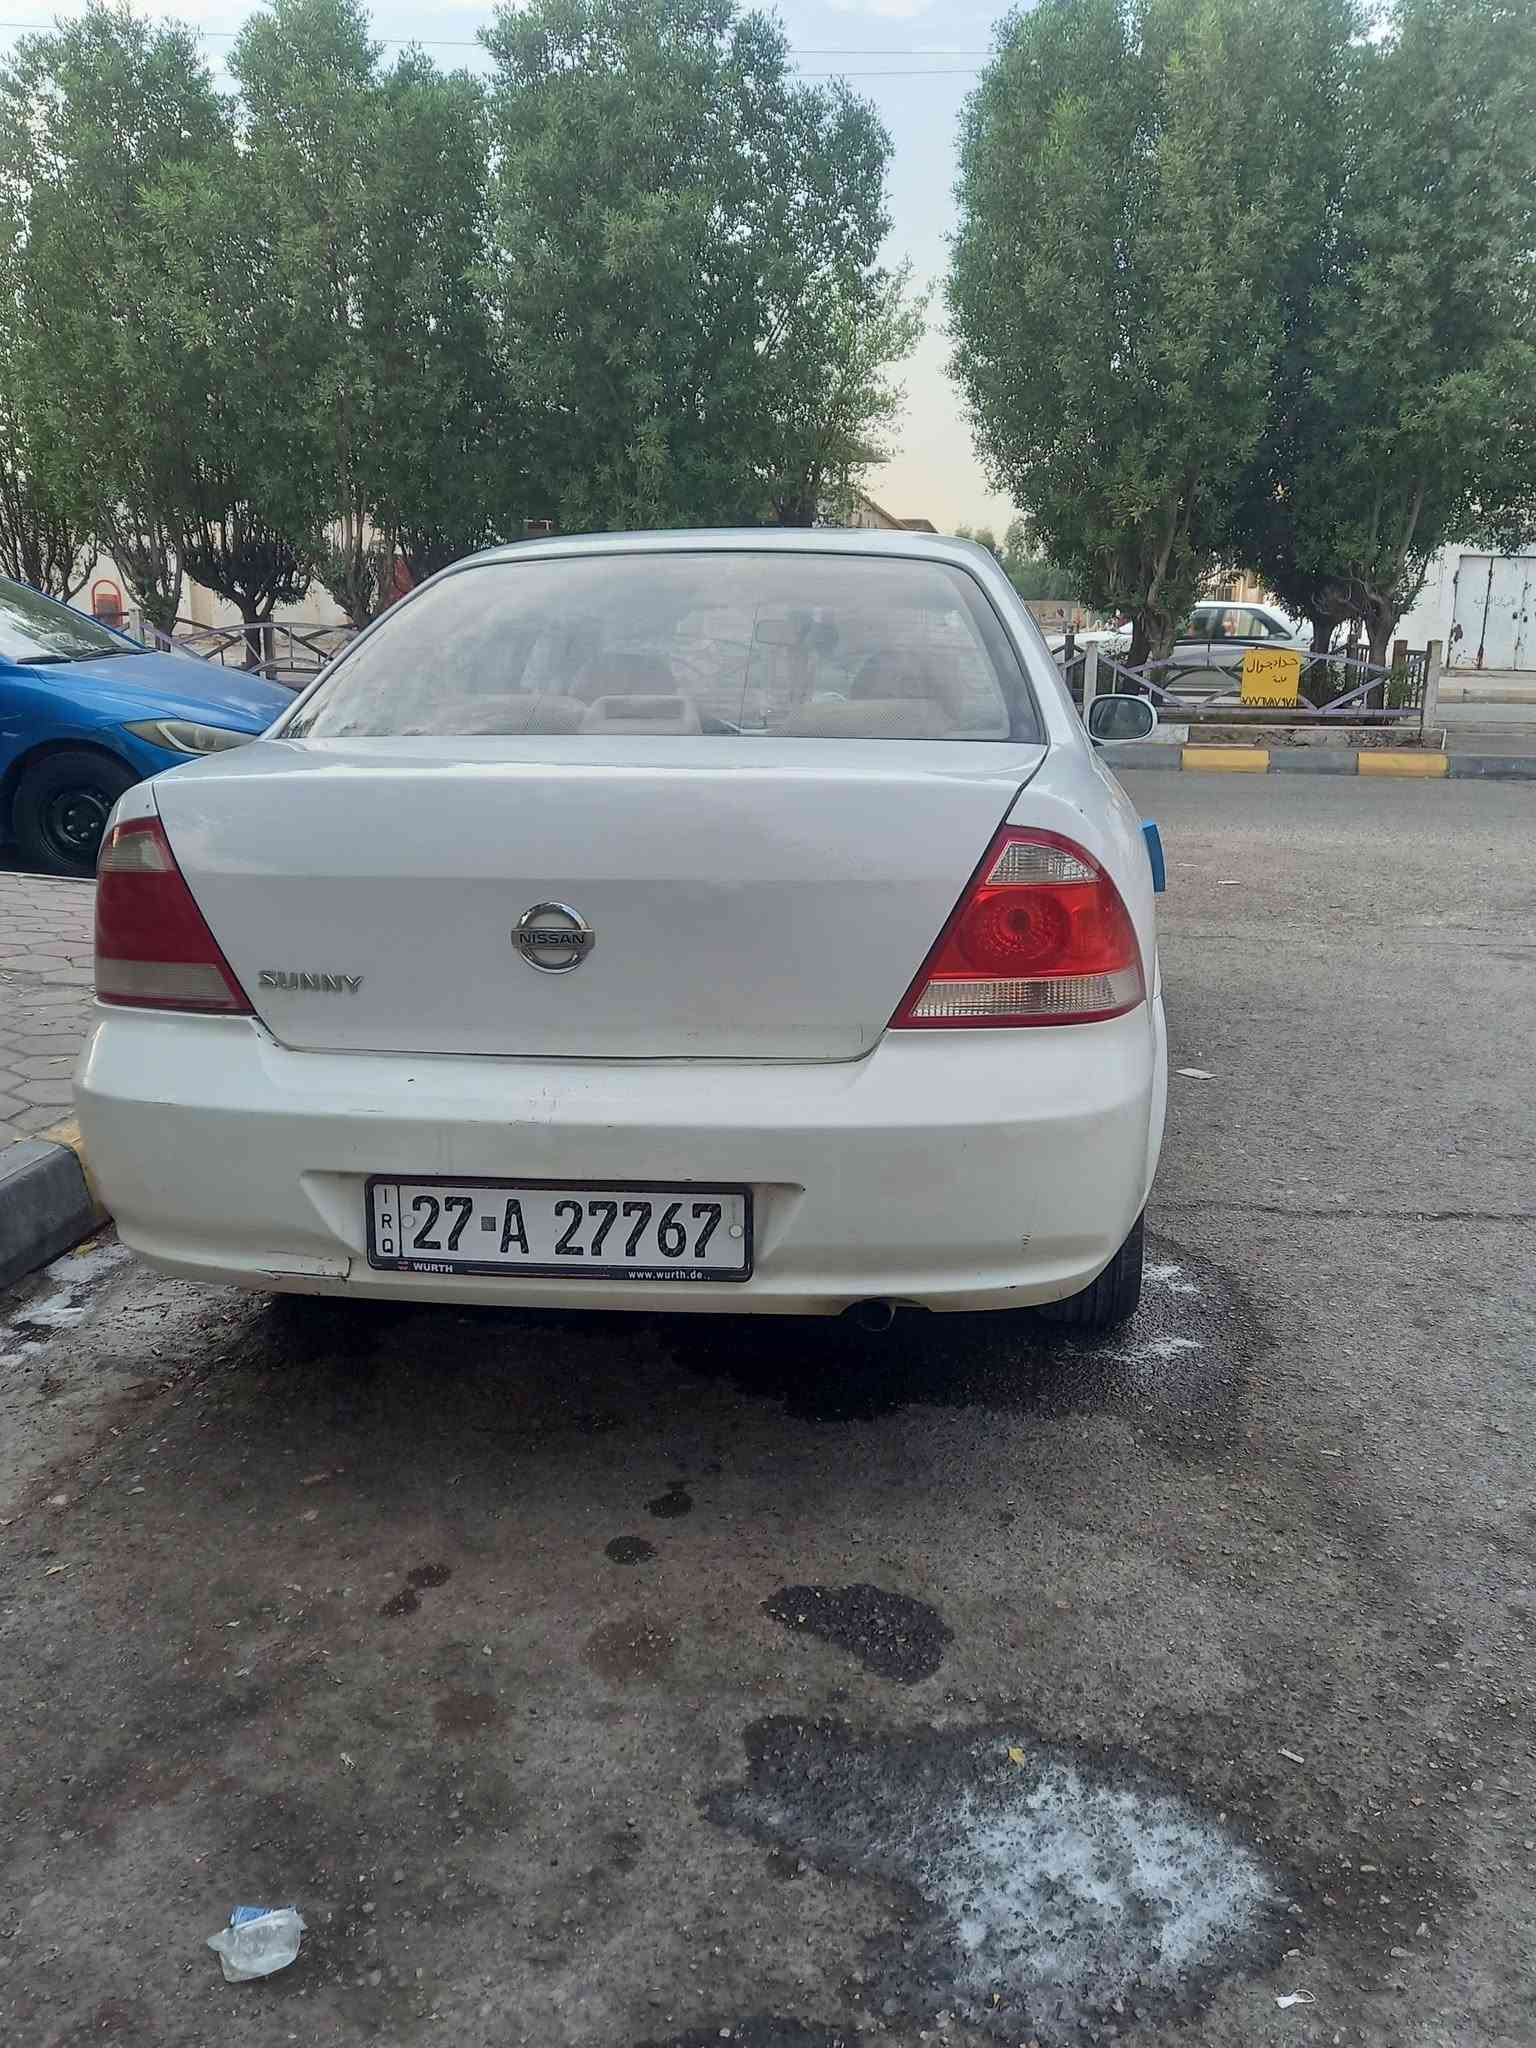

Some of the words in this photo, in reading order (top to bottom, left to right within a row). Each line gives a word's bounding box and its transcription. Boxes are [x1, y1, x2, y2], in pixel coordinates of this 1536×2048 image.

[518, 932, 586, 946] NISSAN
[258, 969, 362, 993] SUNNY
[411, 1195, 473, 1252] 27
[499, 1198, 530, 1255] A
[554, 1199, 722, 1259] 27767
